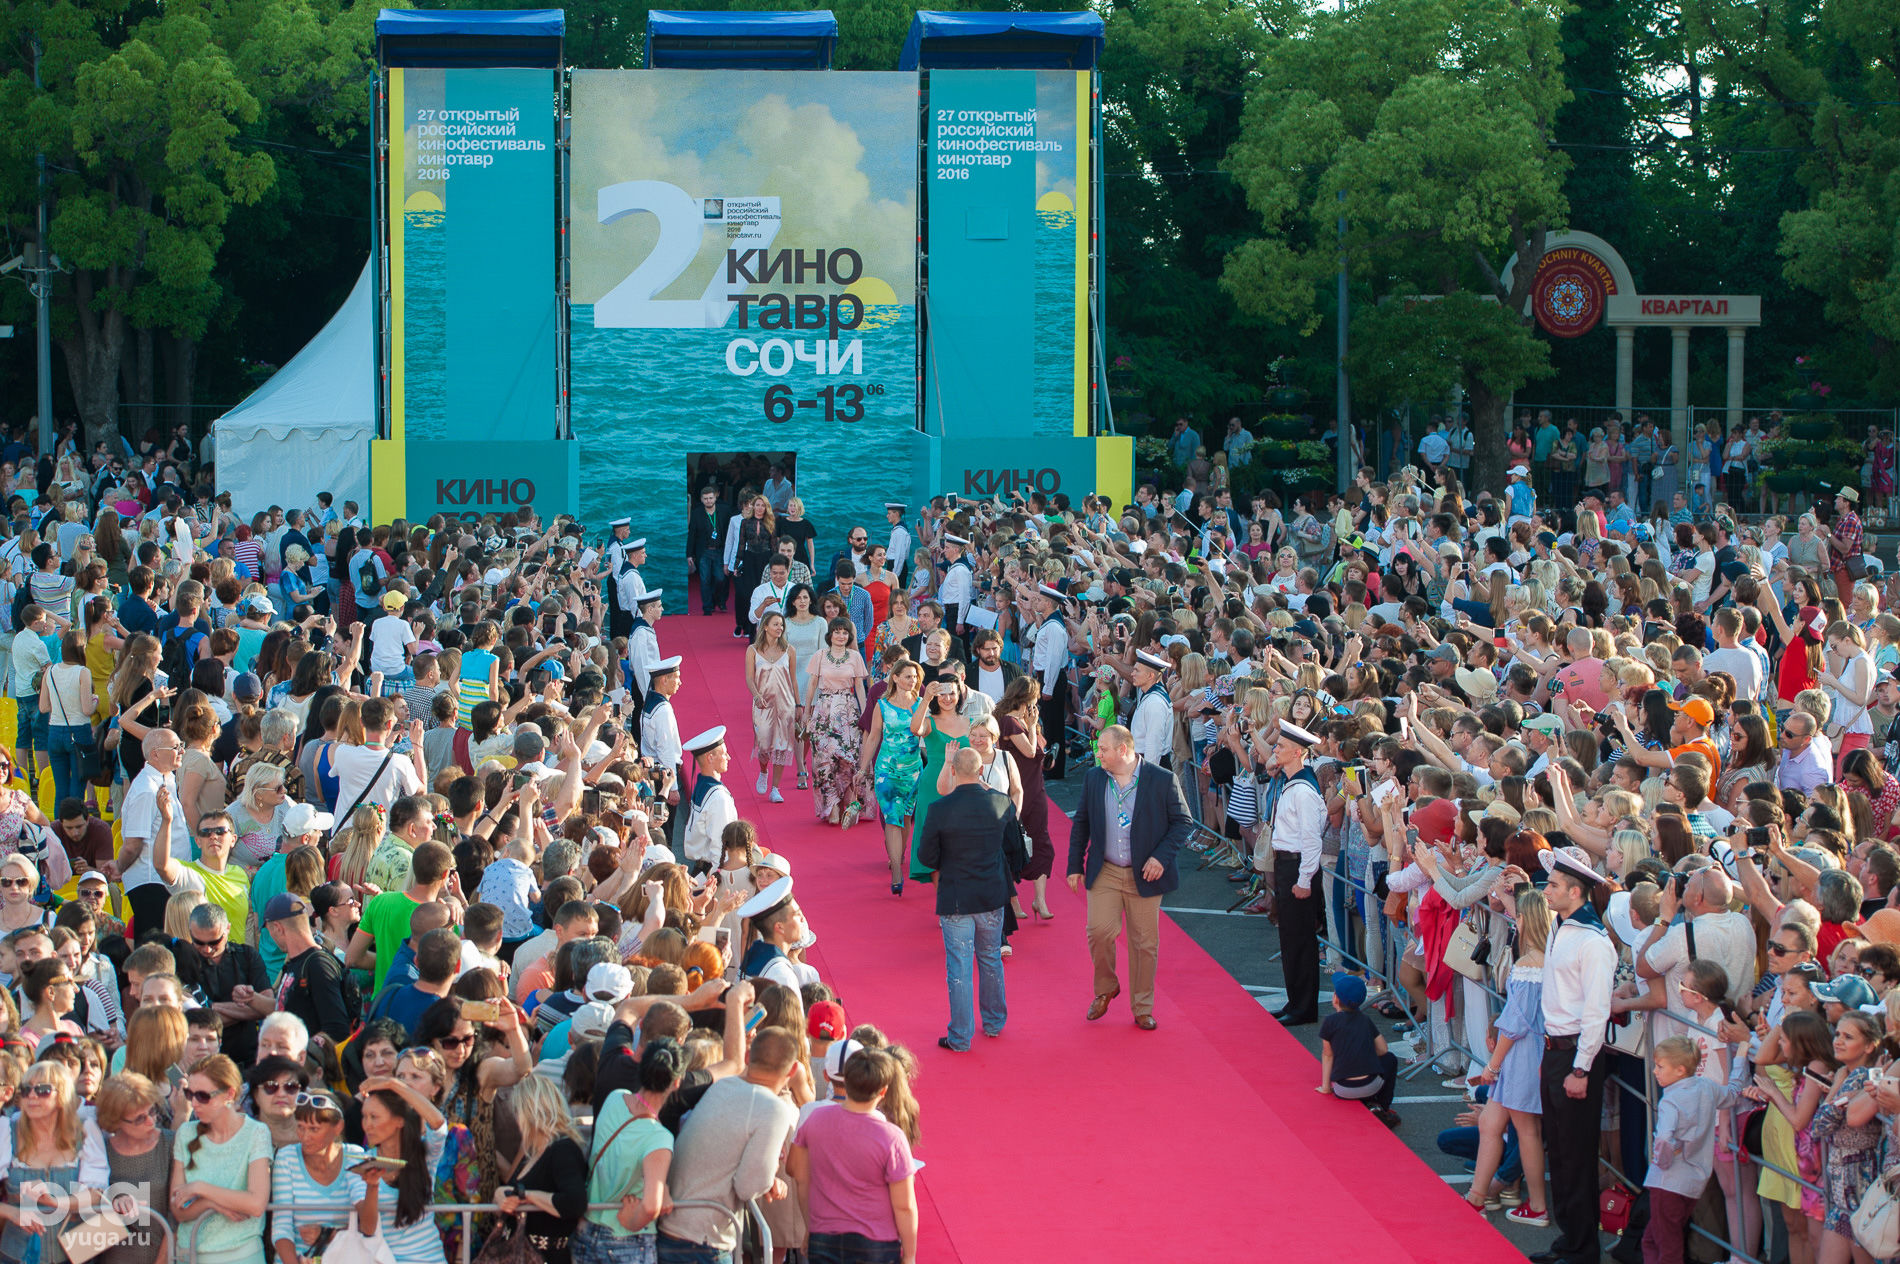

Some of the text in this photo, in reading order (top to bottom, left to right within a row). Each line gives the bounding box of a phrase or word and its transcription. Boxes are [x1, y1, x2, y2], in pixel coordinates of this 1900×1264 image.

[417, 107, 520, 124] 27 открытый
[937, 108, 1037, 124] 27 открытый
[417, 123, 516, 138] российский
[937, 123, 1034, 138] российский
[417, 137, 546, 153] кинофестиваль
[937, 137, 1063, 153] кинофестиваль
[417, 154, 494, 168] кинотавр
[937, 154, 1012, 168] кинотавр
[417, 168, 451, 180] 2016
[937, 168, 970, 180] 2016
[1581, 252, 1615, 294] KVARTAL
[1641, 299, 1728, 316] КВАРТАЛ
[727, 293, 864, 340] тавр
